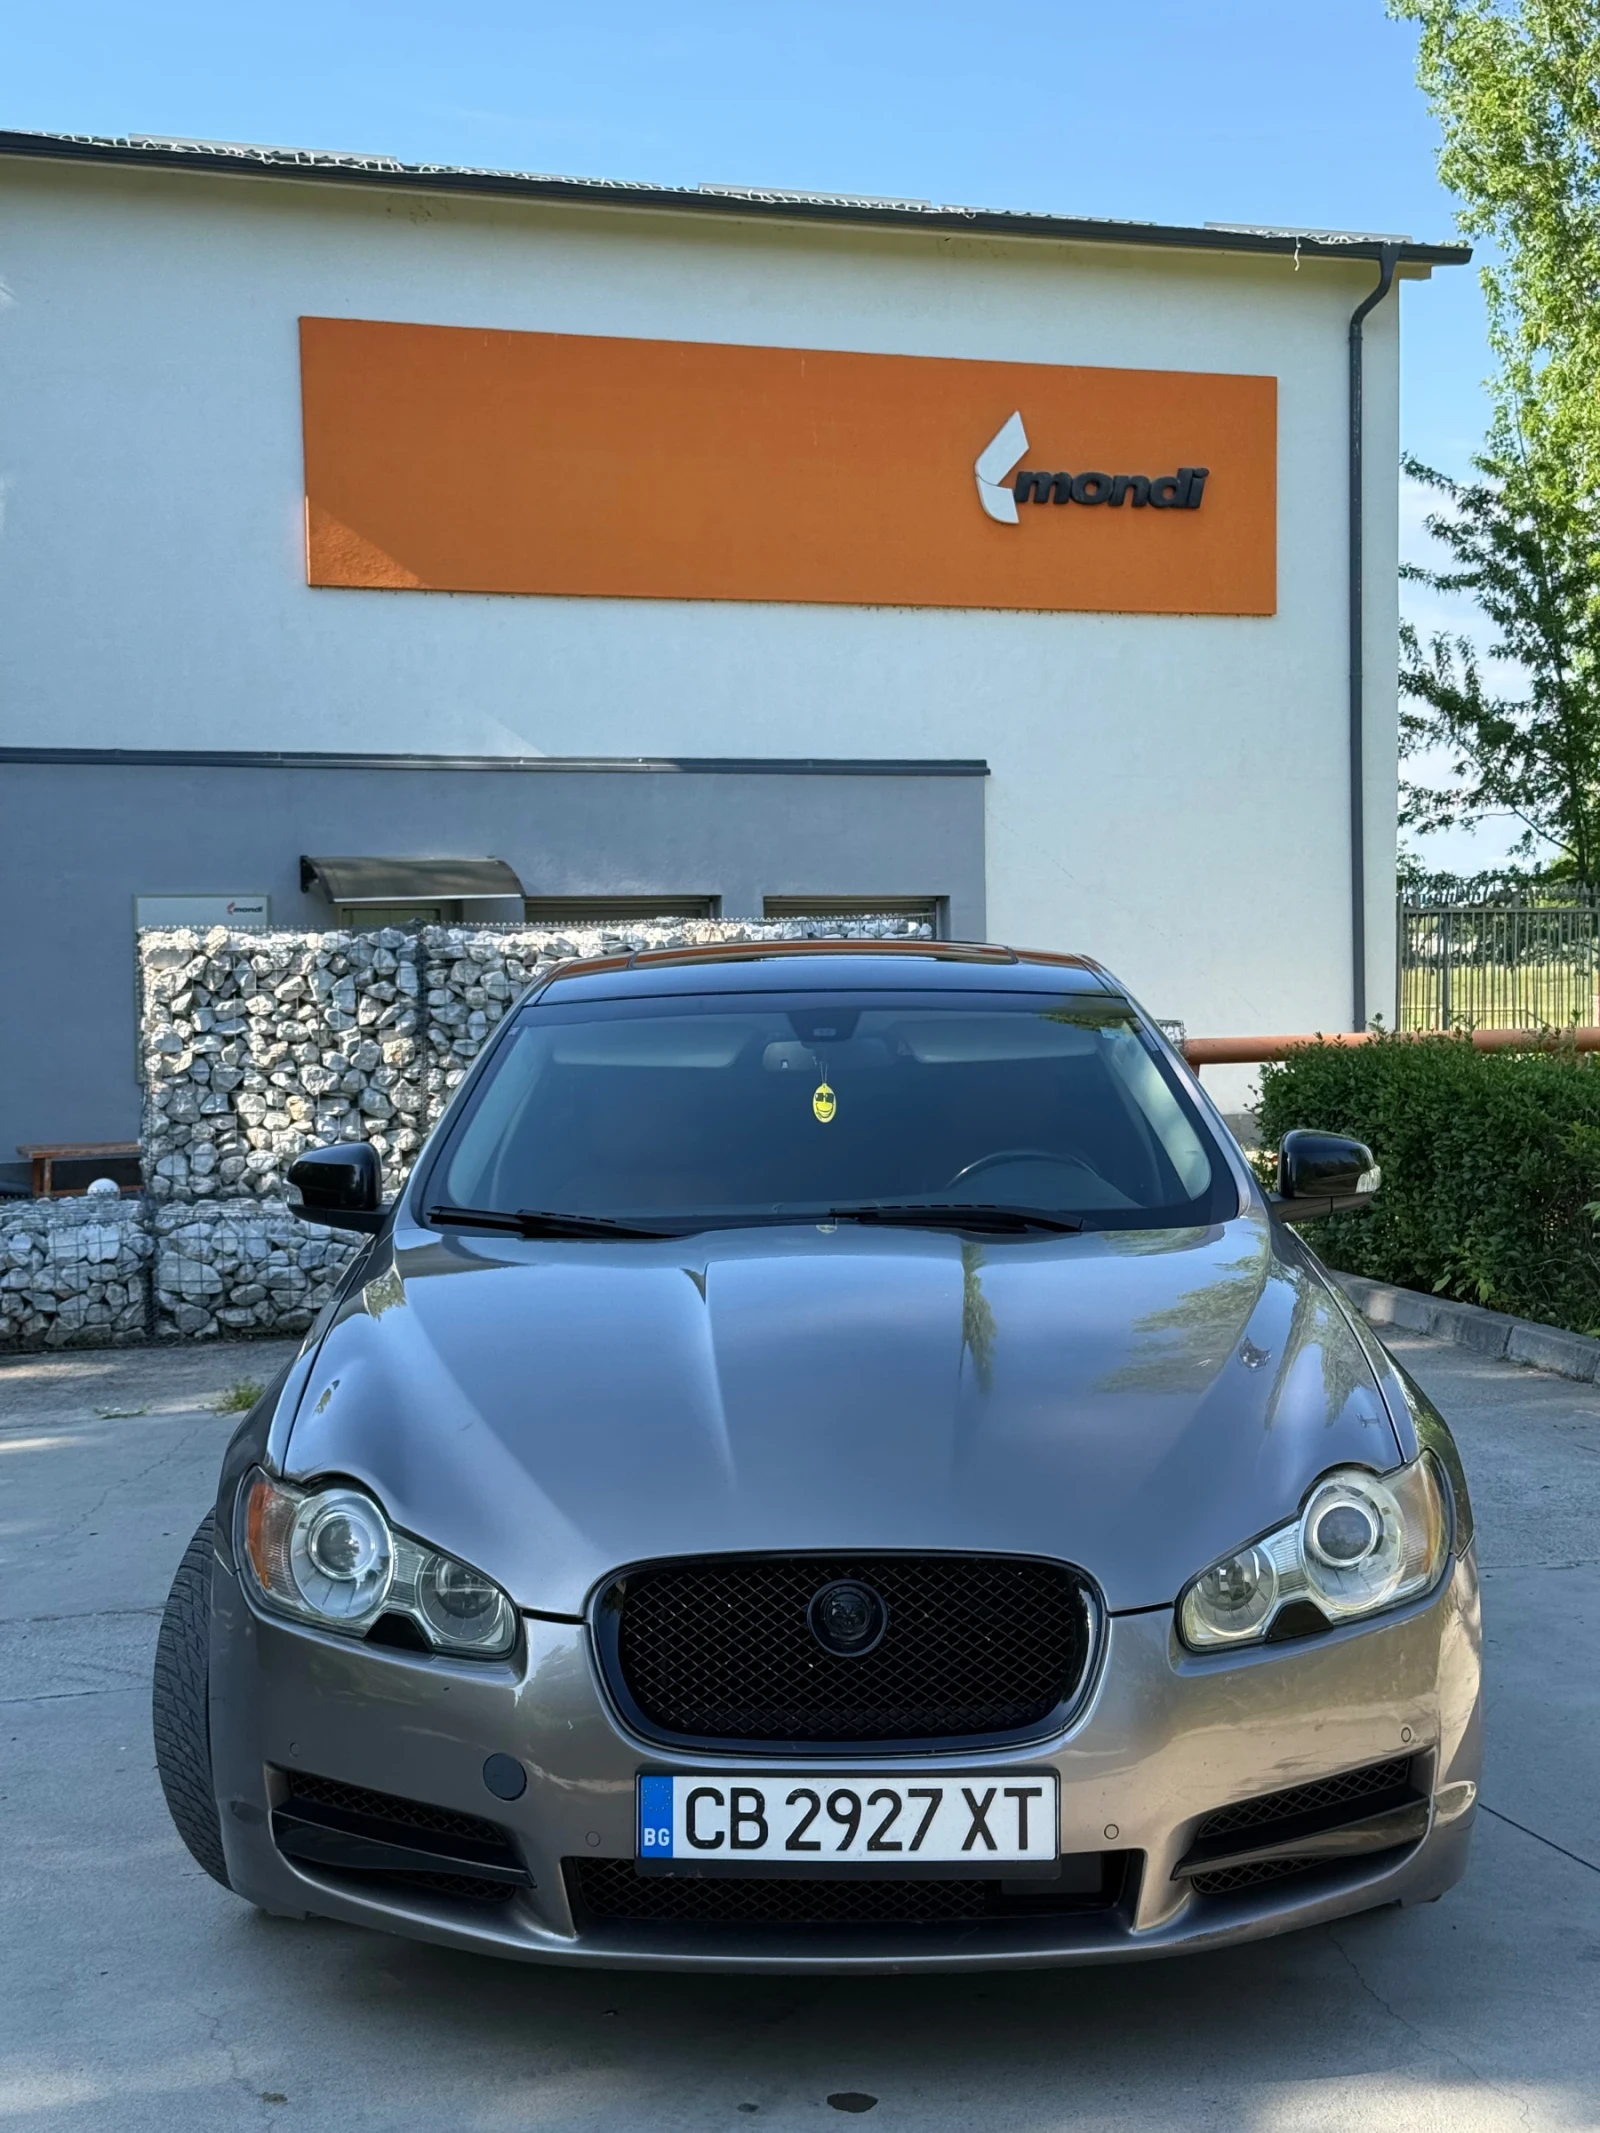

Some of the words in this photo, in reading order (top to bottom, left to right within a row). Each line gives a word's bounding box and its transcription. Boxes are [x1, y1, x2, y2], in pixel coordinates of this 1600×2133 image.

[1014, 467, 1210, 509] mondi
[233, 905, 263, 913] mondi
[685, 1787, 769, 1850] CB
[785, 1788, 944, 1851] 2927
[961, 1787, 1043, 1850] XT
[643, 1828, 670, 1847] BG
